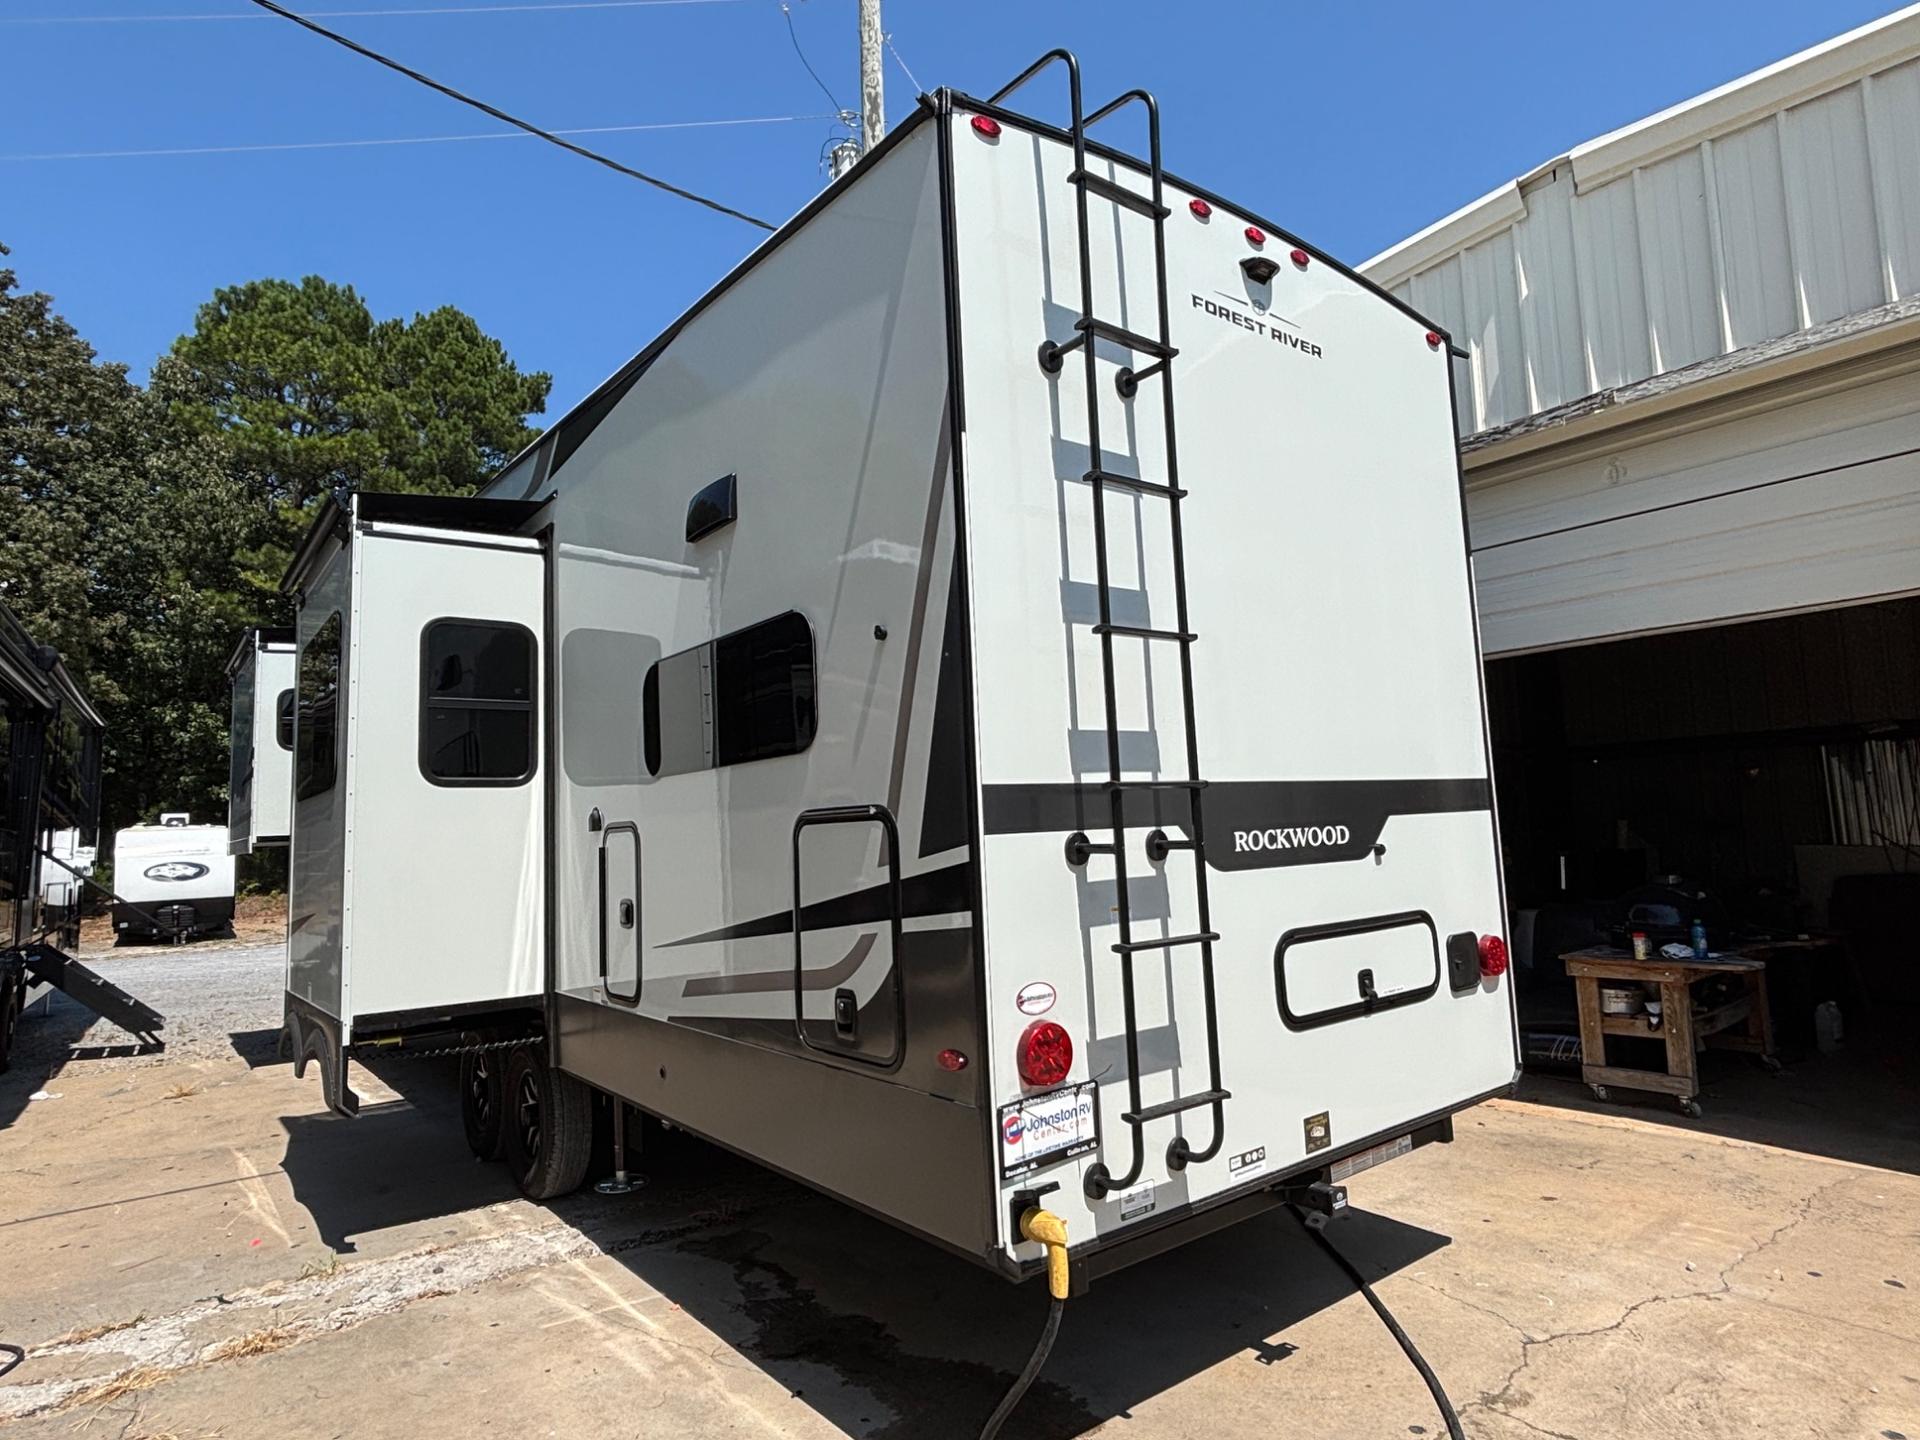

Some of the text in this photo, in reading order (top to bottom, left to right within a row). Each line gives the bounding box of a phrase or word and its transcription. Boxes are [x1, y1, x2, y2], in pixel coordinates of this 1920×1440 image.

[1191, 294, 1323, 359] FOREST RIVER
[1234, 825, 1350, 852] ROCKWOOD
[1026, 1102, 1092, 1132] Johnston RV
